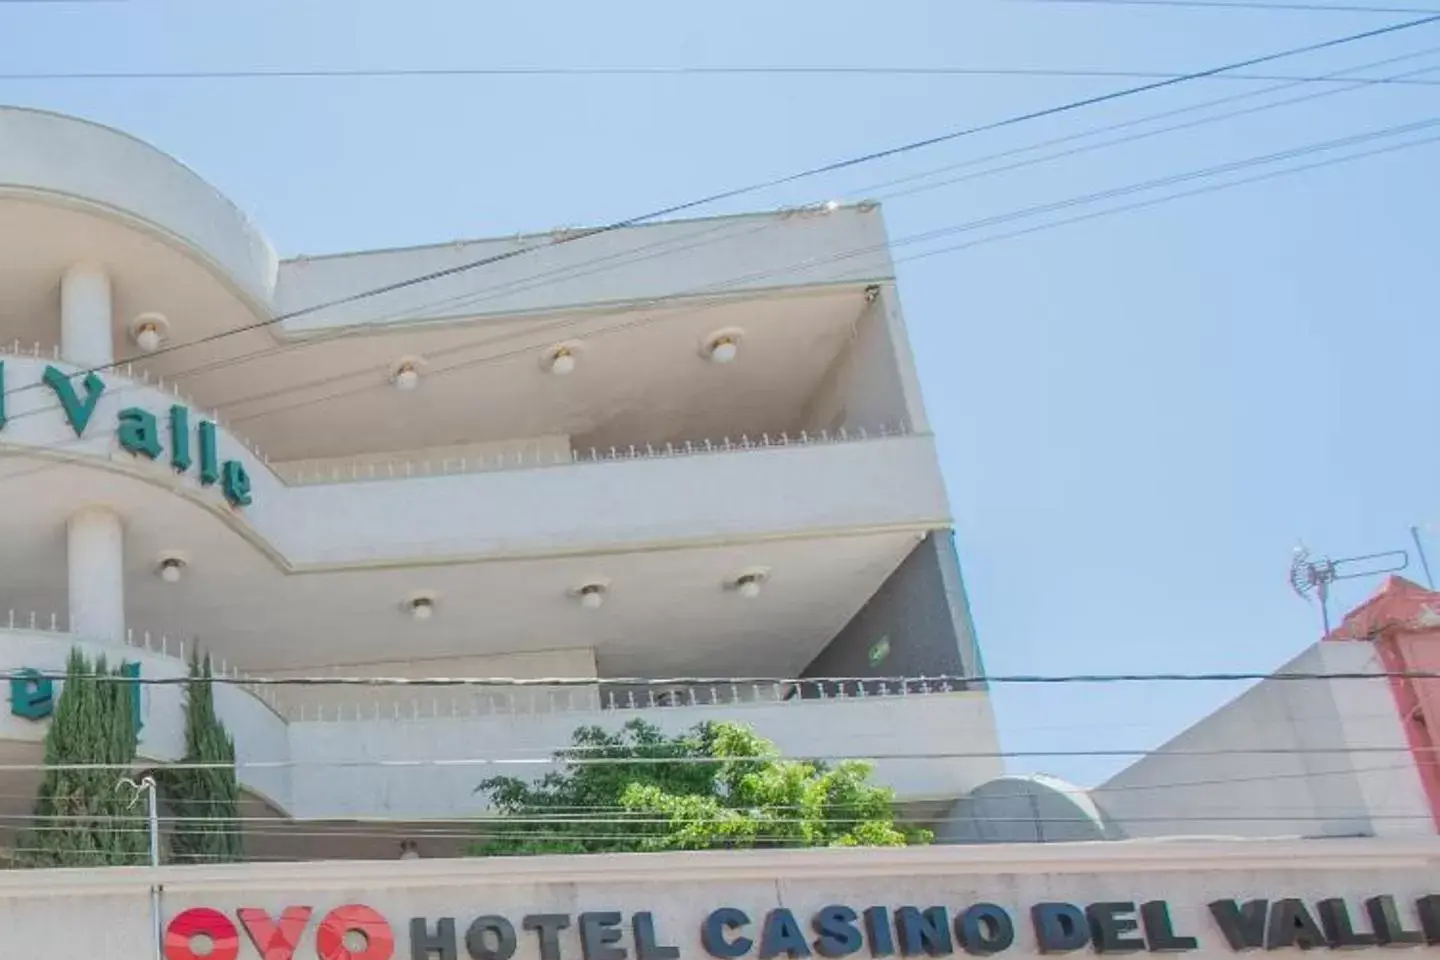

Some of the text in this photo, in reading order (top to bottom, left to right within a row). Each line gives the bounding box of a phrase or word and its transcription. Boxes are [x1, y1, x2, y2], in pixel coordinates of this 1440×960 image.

[42, 364, 252, 507] Valle
[701, 902, 1015, 960] CASINO
[1030, 899, 1198, 956] DEL
